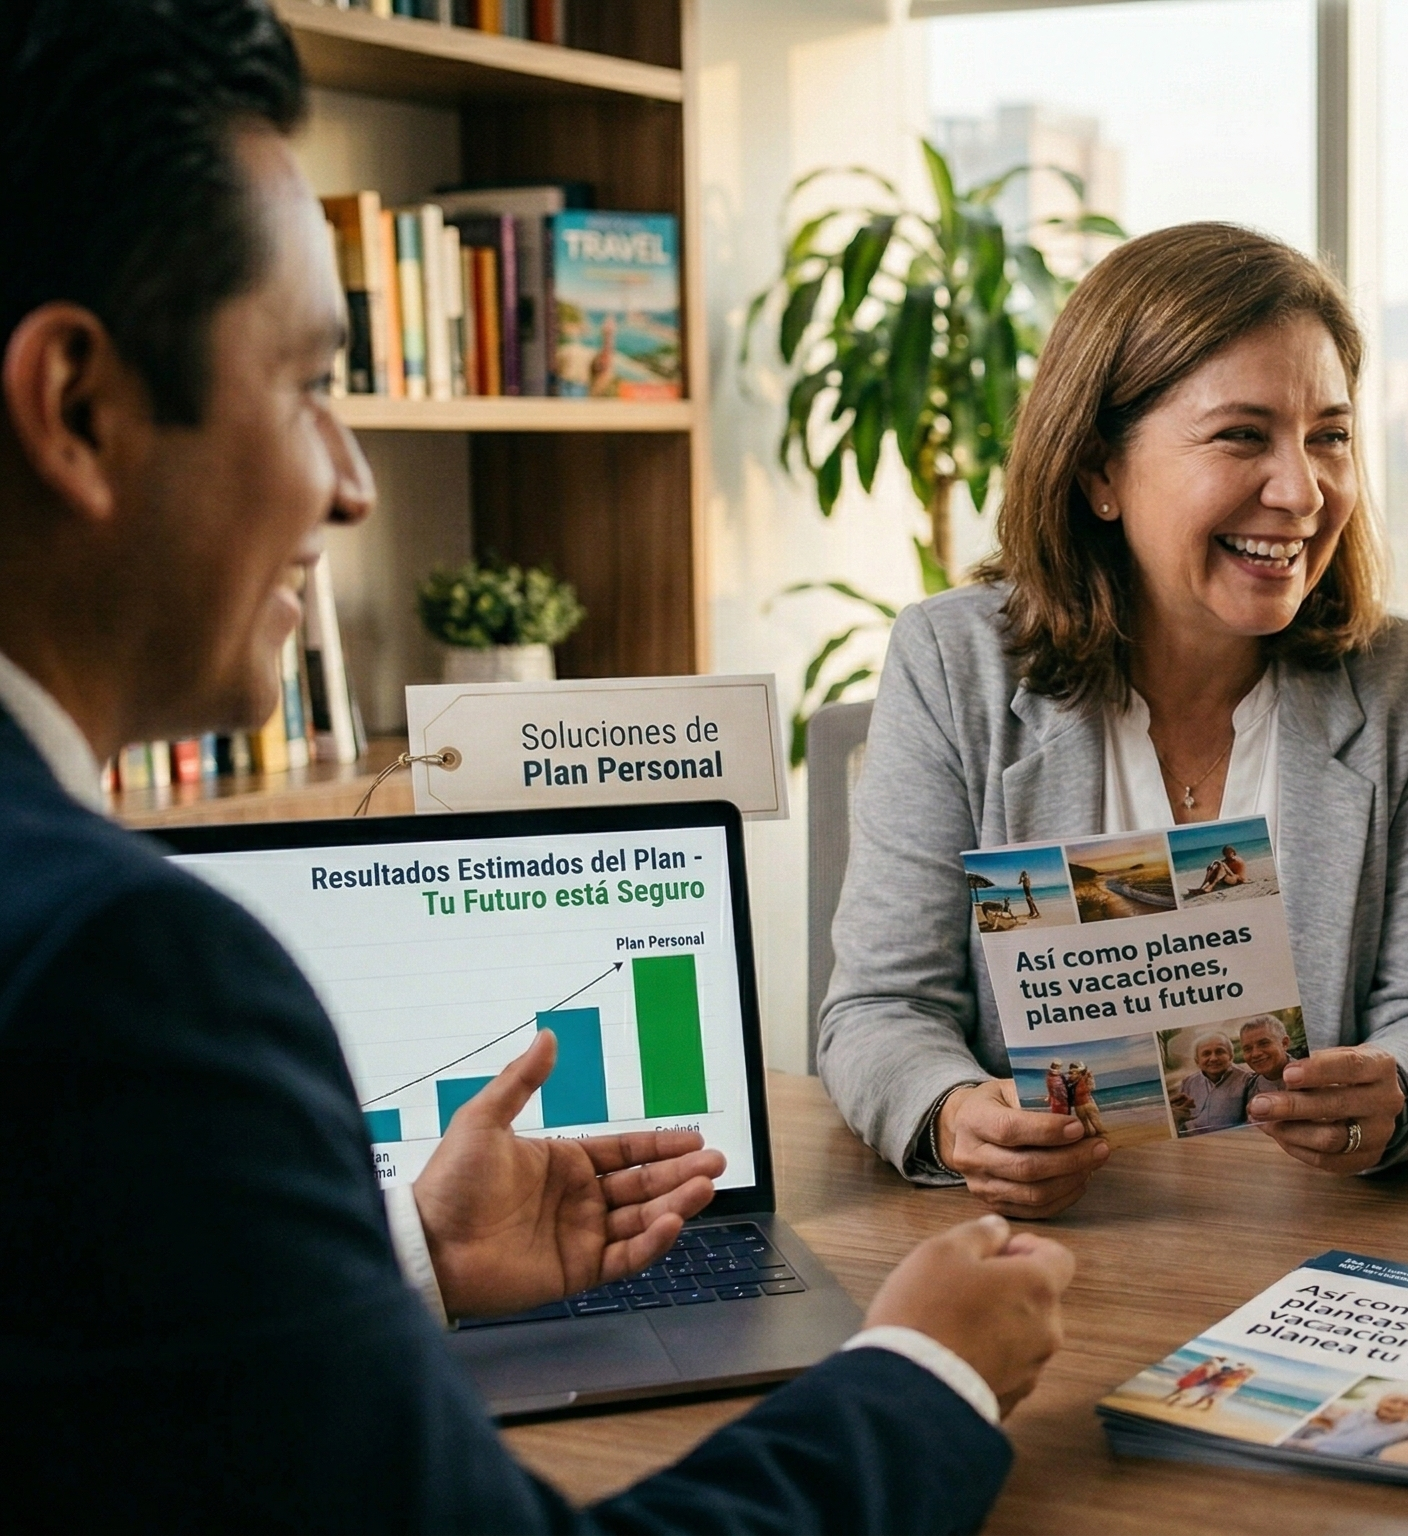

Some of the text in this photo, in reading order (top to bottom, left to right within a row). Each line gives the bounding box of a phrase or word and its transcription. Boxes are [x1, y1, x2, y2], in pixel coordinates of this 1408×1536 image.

[562, 229, 672, 265] TRAVEL
[521, 715, 719, 751] Soluciones de
[523, 751, 723, 786] Plan Personal
[311, 860, 450, 890] Resultados
[458, 852, 584, 881] Estimados
[591, 849, 626, 873] del
[634, 847, 686, 871] Plan
[422, 880, 705, 915] Tu Futuro está Seguro
[616, 931, 705, 950] Plan Personal
[1016, 925, 1252, 973] Así como planeas
[1020, 957, 1229, 999] tus vacaciones,
[1026, 979, 1244, 1030] planea tu futuro
[1296, 1285, 1356, 1302] Así
[1245, 1323, 1358, 1355] planea
[1366, 1347, 1401, 1363] tu
